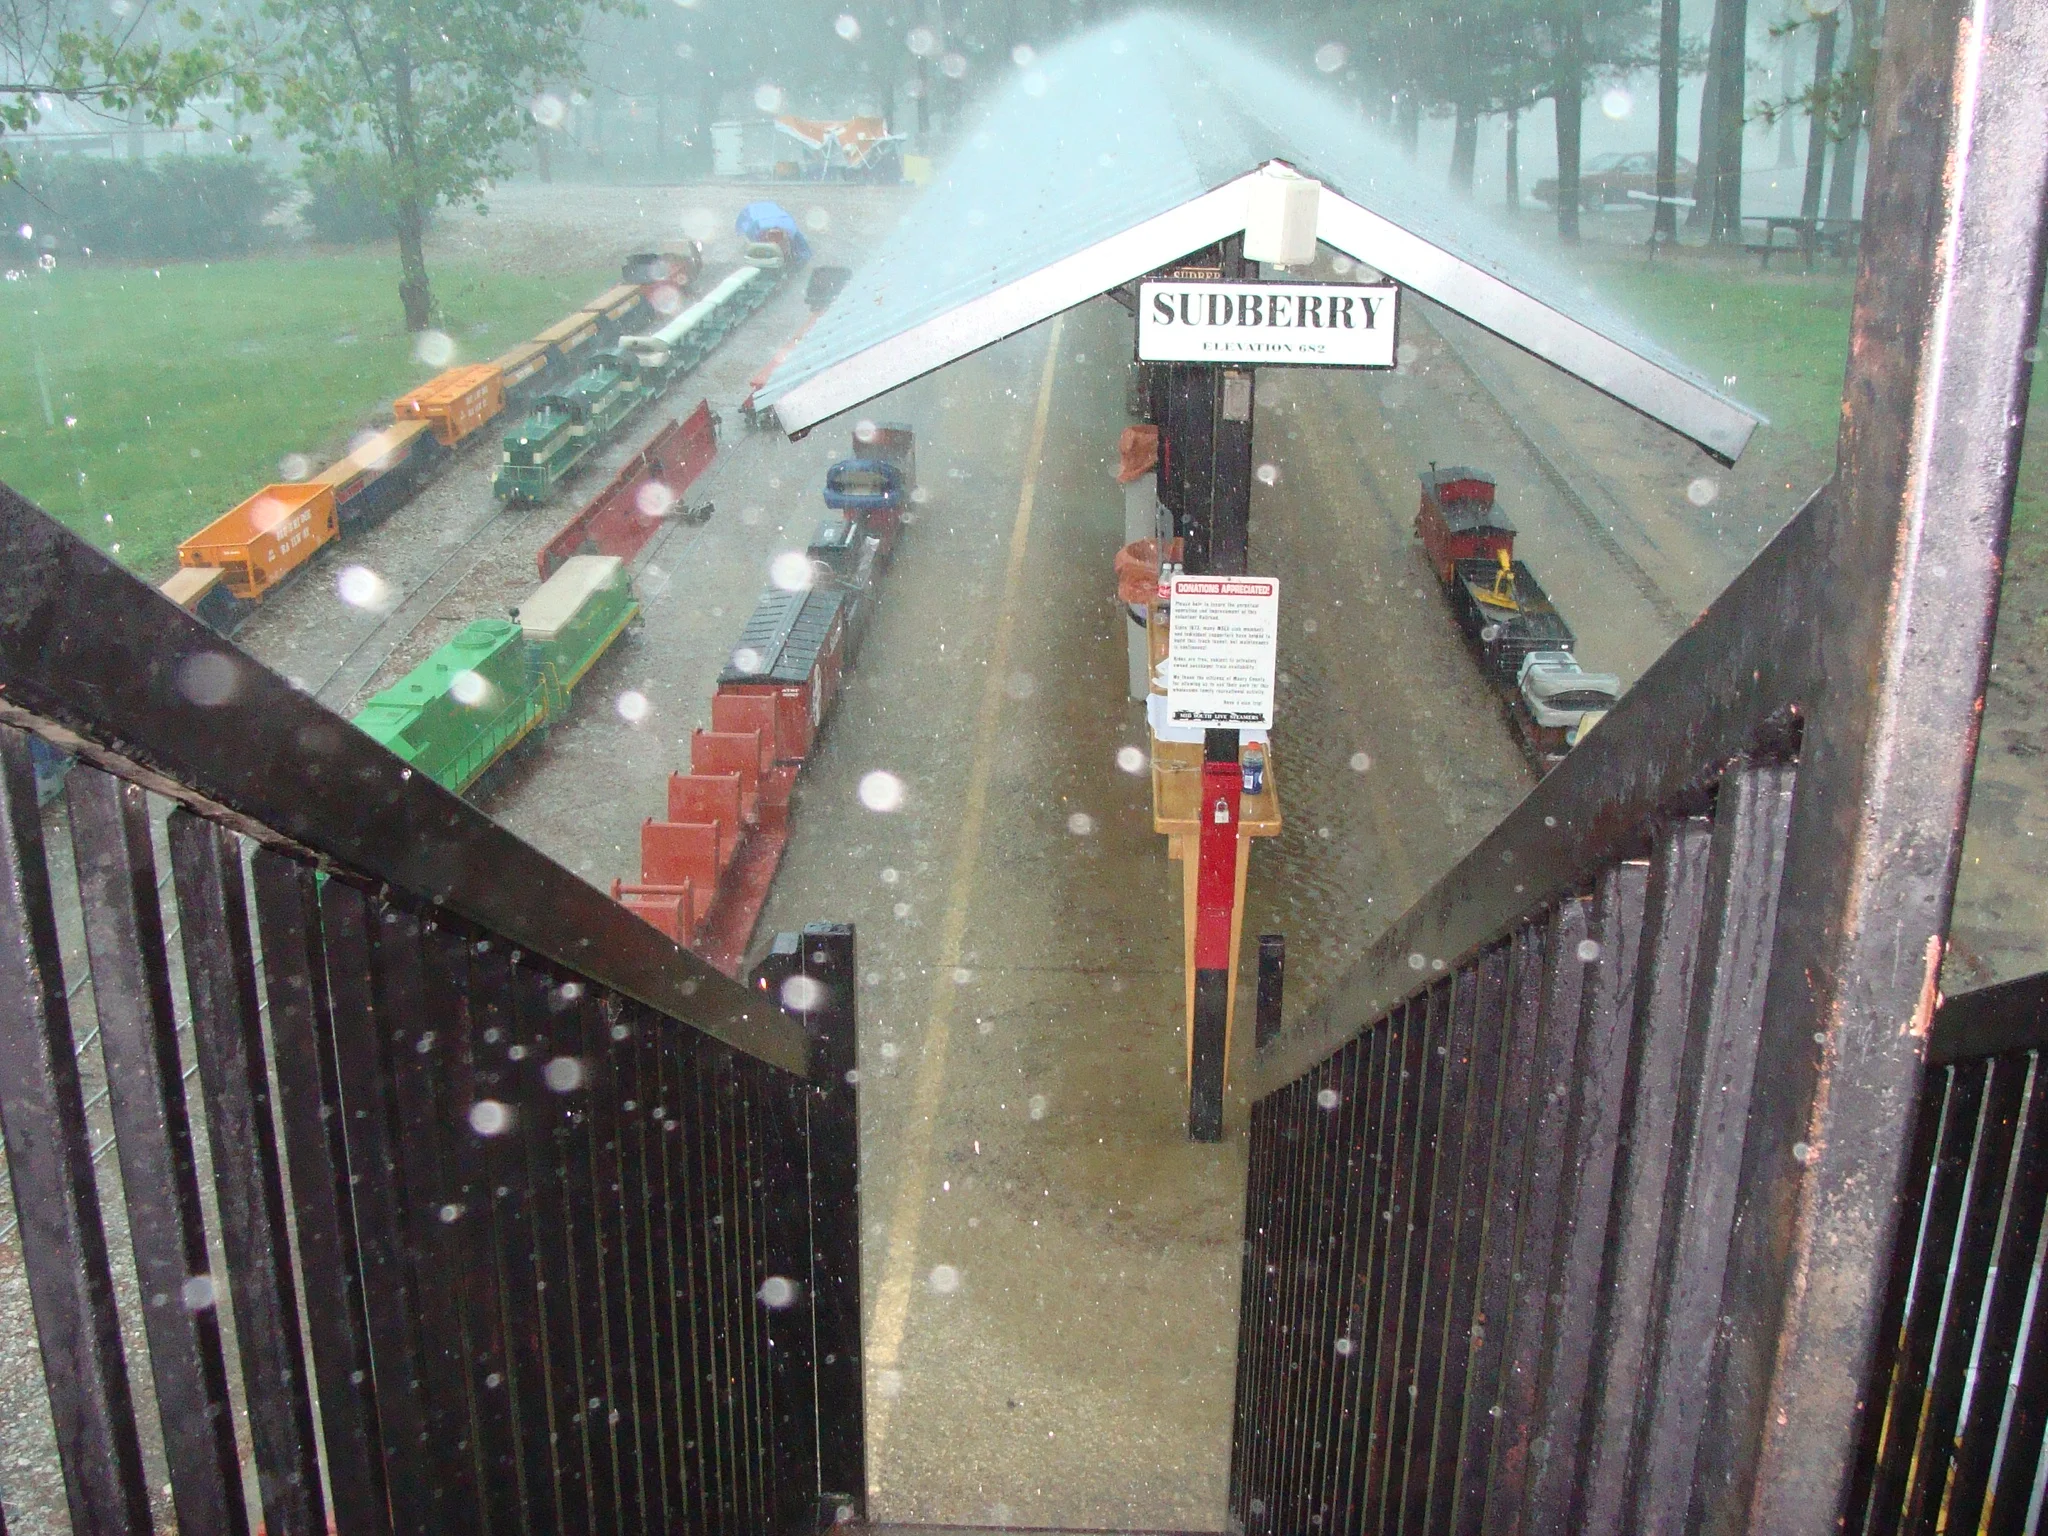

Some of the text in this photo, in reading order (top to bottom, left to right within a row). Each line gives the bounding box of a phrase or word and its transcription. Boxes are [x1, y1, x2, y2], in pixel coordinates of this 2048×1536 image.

[1152, 293, 1384, 330] SUDBERRY
[1203, 342, 1326, 354] ELEVATION 682
[1178, 583, 1219, 593] DONATIONS
[1221, 584, 1270, 595] APPRECIATED!
